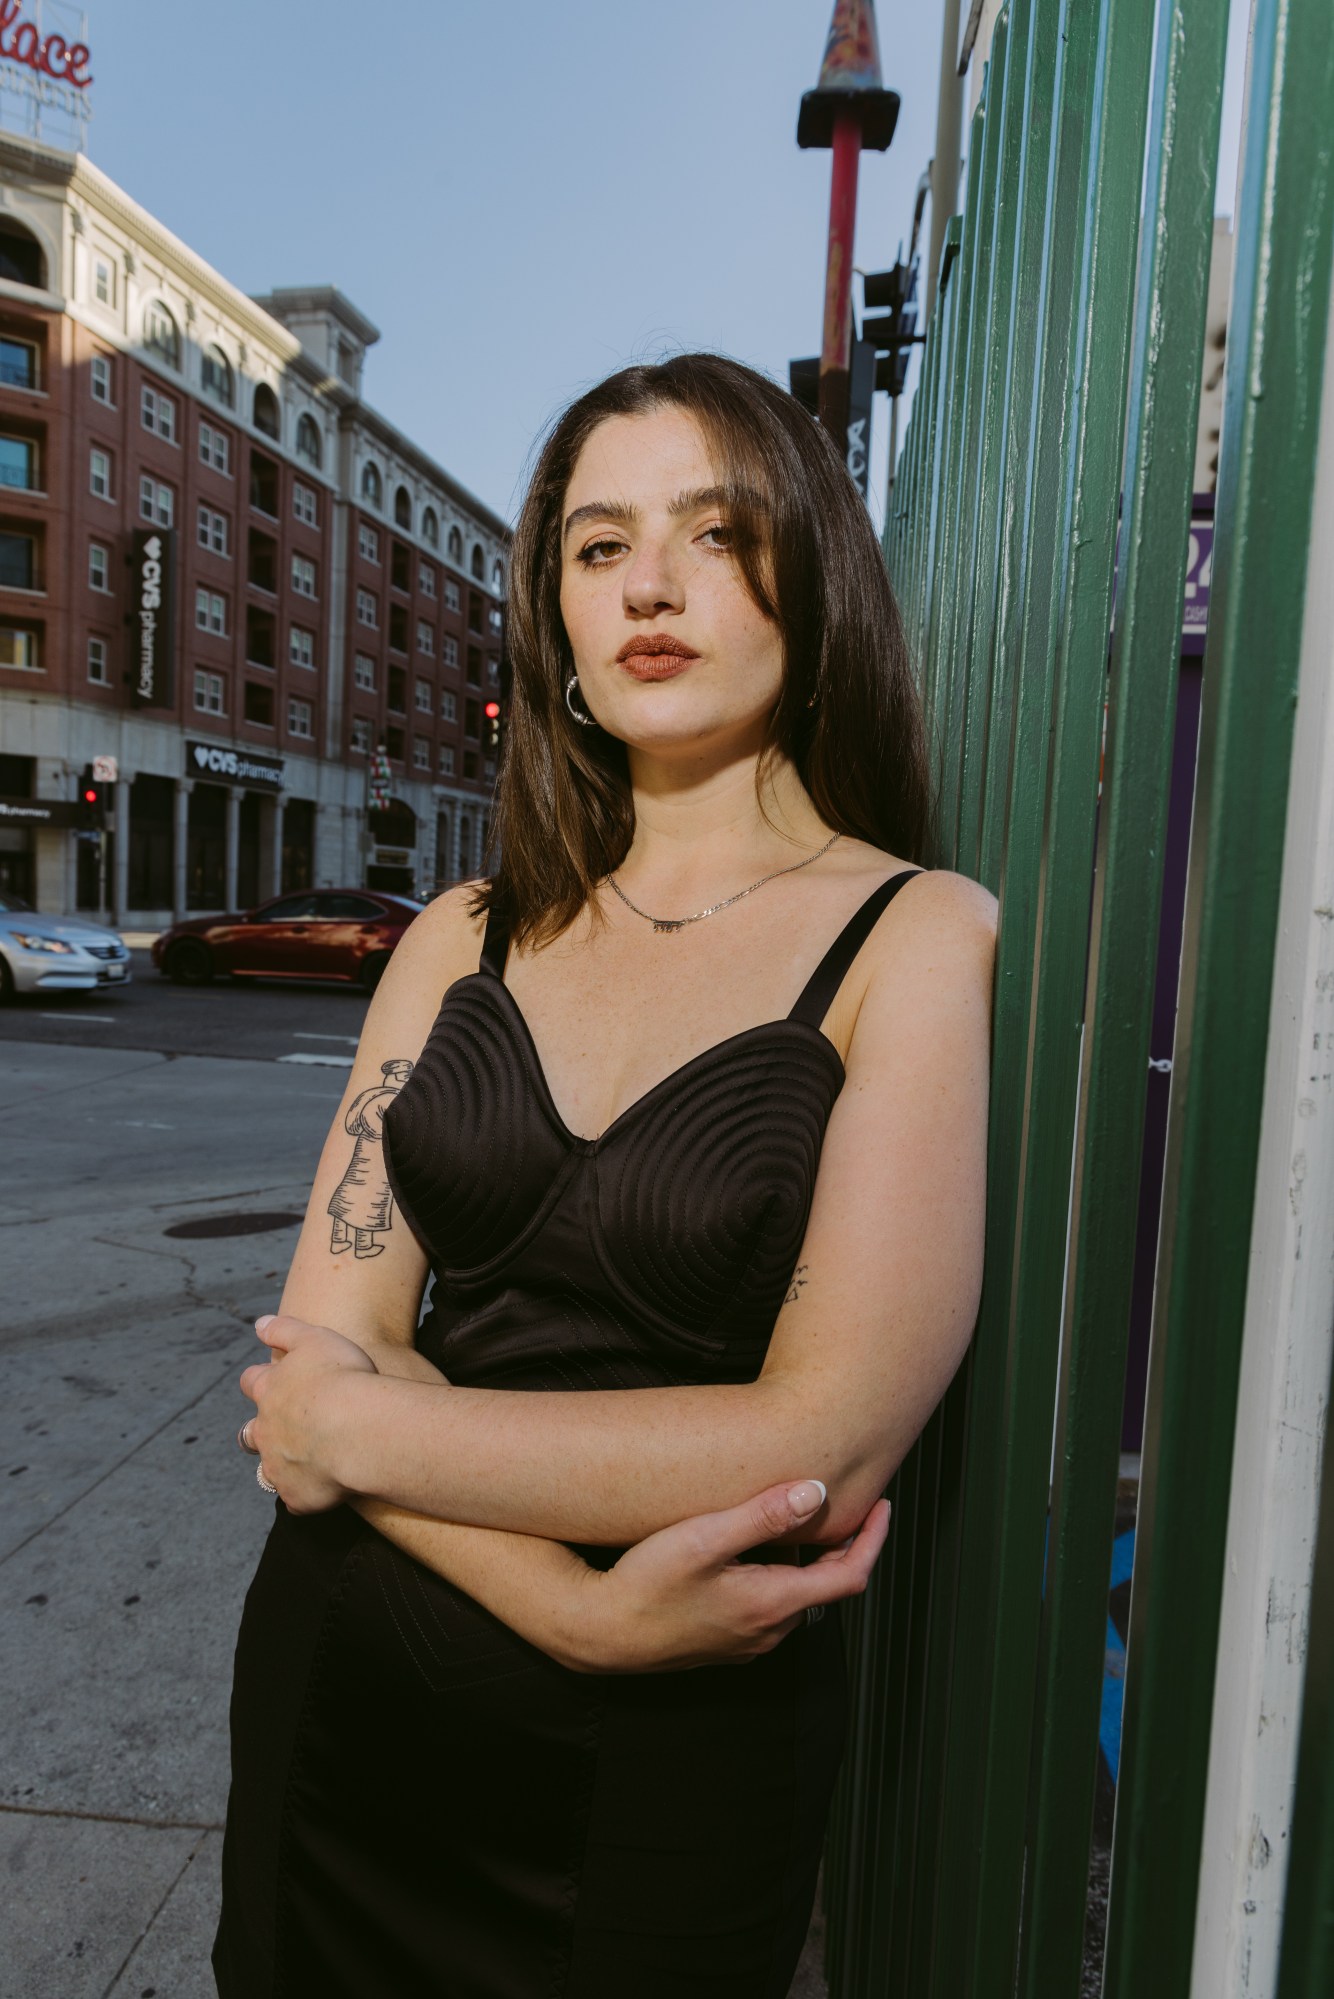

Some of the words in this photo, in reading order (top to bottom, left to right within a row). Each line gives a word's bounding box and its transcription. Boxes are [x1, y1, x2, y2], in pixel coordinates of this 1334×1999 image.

[142, 560, 162, 610] CVS
[137, 611, 157, 699] pharmacy
[208, 749, 238, 775] CVS
[237, 759, 286, 787] pharmacy
